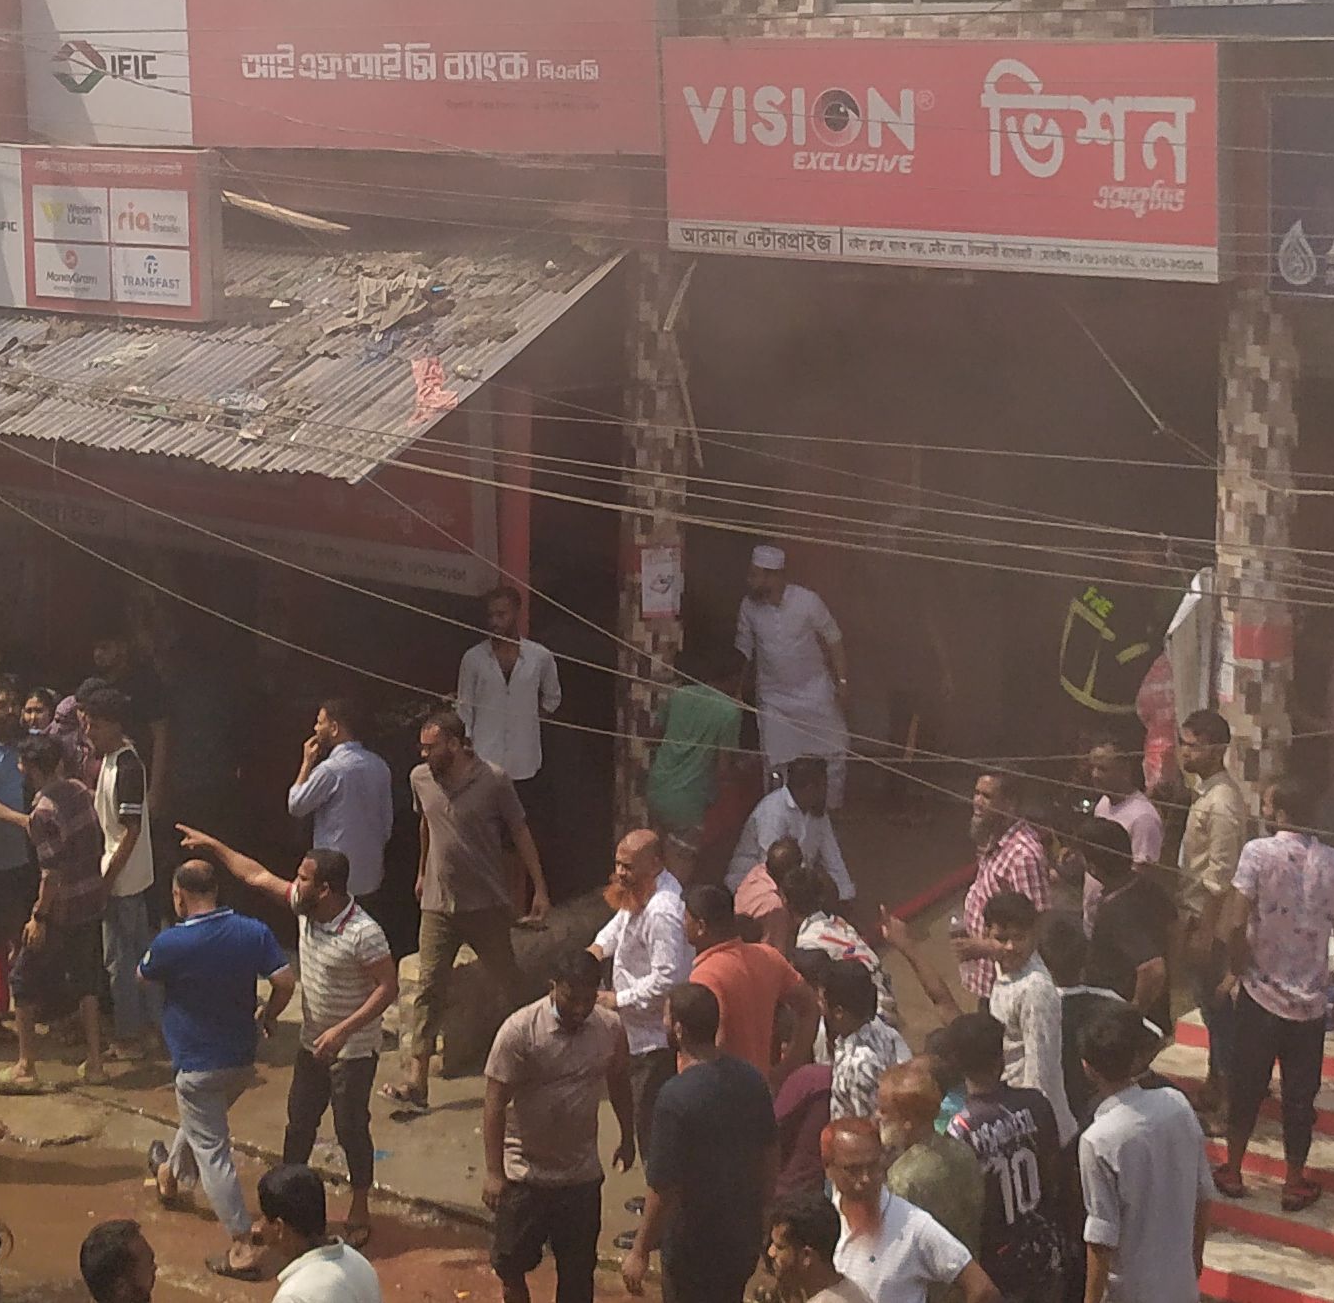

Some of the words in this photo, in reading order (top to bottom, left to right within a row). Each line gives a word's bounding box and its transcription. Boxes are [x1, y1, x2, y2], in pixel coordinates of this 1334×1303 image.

[110, 55, 157, 79] IFIC
[443, 51, 529, 81] ব্যাংক
[536, 59, 600, 80] পিএলসি
[682, 85, 915, 152] VISION
[981, 58, 1196, 184] ভিশন
[793, 151, 915, 174] EXCLUSIVE
[68, 215, 93, 226] Union
[118, 202, 151, 231] ria
[680, 227, 738, 247] আরমান
[743, 227, 834, 254] এন্টারপ্রাইজ
[46, 271, 99, 286] MoneyGram
[122, 275, 181, 290] TRANSFAST
[980, 1147, 1041, 1225] 10
